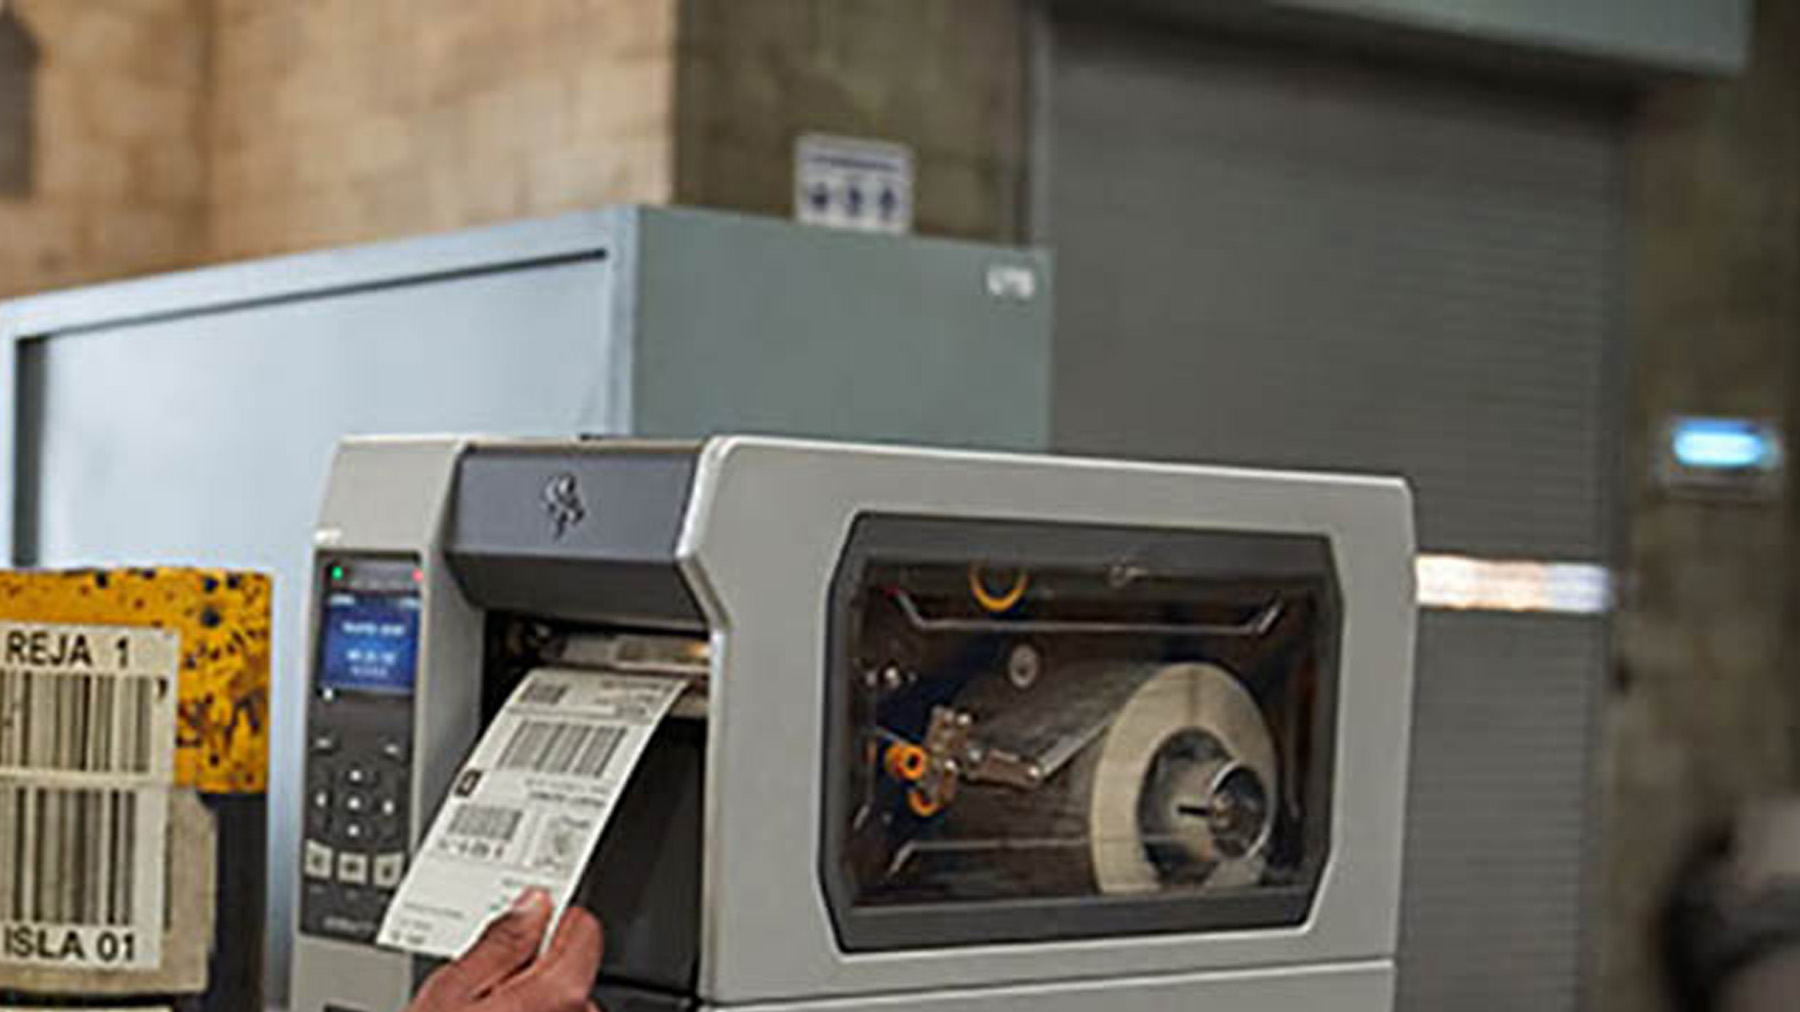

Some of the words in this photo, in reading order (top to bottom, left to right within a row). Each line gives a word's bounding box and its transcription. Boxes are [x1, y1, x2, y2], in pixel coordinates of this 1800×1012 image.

[4, 631, 92, 667] REJA
[114, 637, 129, 668] 1
[3, 927, 86, 961] ISLA
[96, 932, 136, 963] 01
